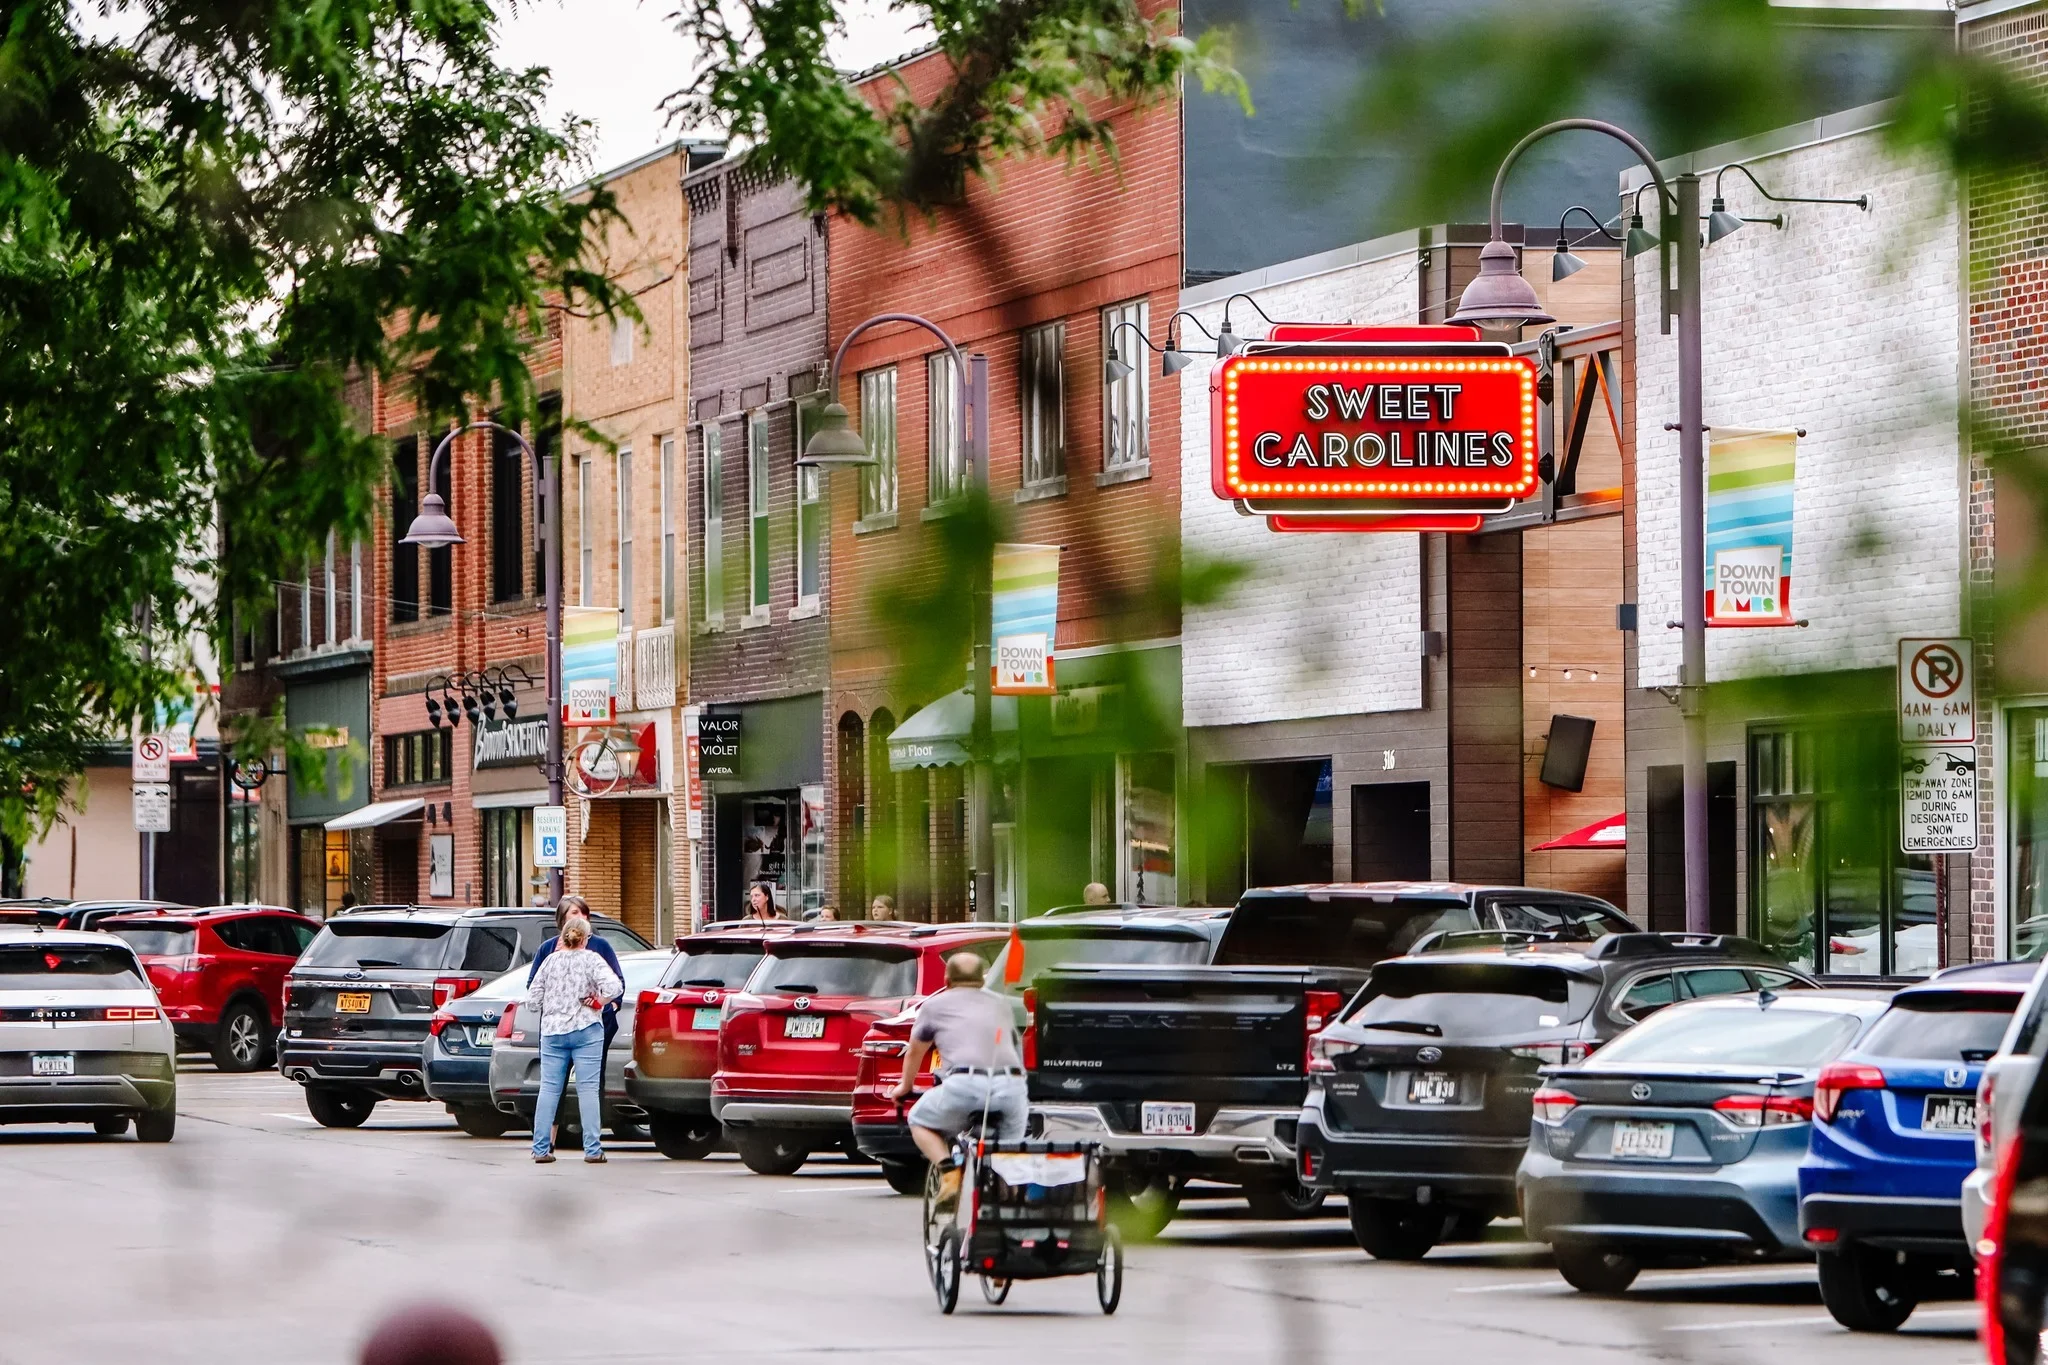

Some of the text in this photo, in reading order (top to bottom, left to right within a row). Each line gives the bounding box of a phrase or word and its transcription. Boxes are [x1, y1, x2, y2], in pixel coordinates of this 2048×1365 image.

[1306, 384, 1462, 420] SWEET
[1254, 431, 1514, 467] CAROLINES
[1720, 564, 1775, 580] DOWN
[1720, 580, 1774, 595] TOWN
[1720, 596, 1774, 612] AMES
[1001, 646, 1042, 659] DOWN
[1001, 658, 1042, 670] TOWN
[1002, 671, 1043, 683] AMES
[571, 689, 606, 699] DOWN
[571, 698, 606, 708] TOWN
[1942, 701, 1971, 716] 6AM
[572, 708, 606, 718] AMES
[700, 720, 739, 731] VALOR
[1917, 722, 1957, 737] DAILY
[715, 734, 723, 743] &
[701, 745, 738, 756] VIOLET
[908, 745, 933, 757] Floor
[1382, 749, 1396, 771] 316
[1905, 777, 1972, 788] TOW-AWAY ZONE
[1906, 789, 1973, 800] 12MID TO 6AM
[1921, 801, 1957, 812] DURING
[536, 815, 562, 824] RESERVED
[1910, 813, 1969, 824] DESIGNATED
[538, 825, 561, 834] PARKING
[1926, 825, 1953, 835] SNOW
[1907, 836, 1972, 847] EMERGENCIES
[1043, 1059, 1103, 1068] SILVERADO
[1276, 1063, 1296, 1072] LTZ
